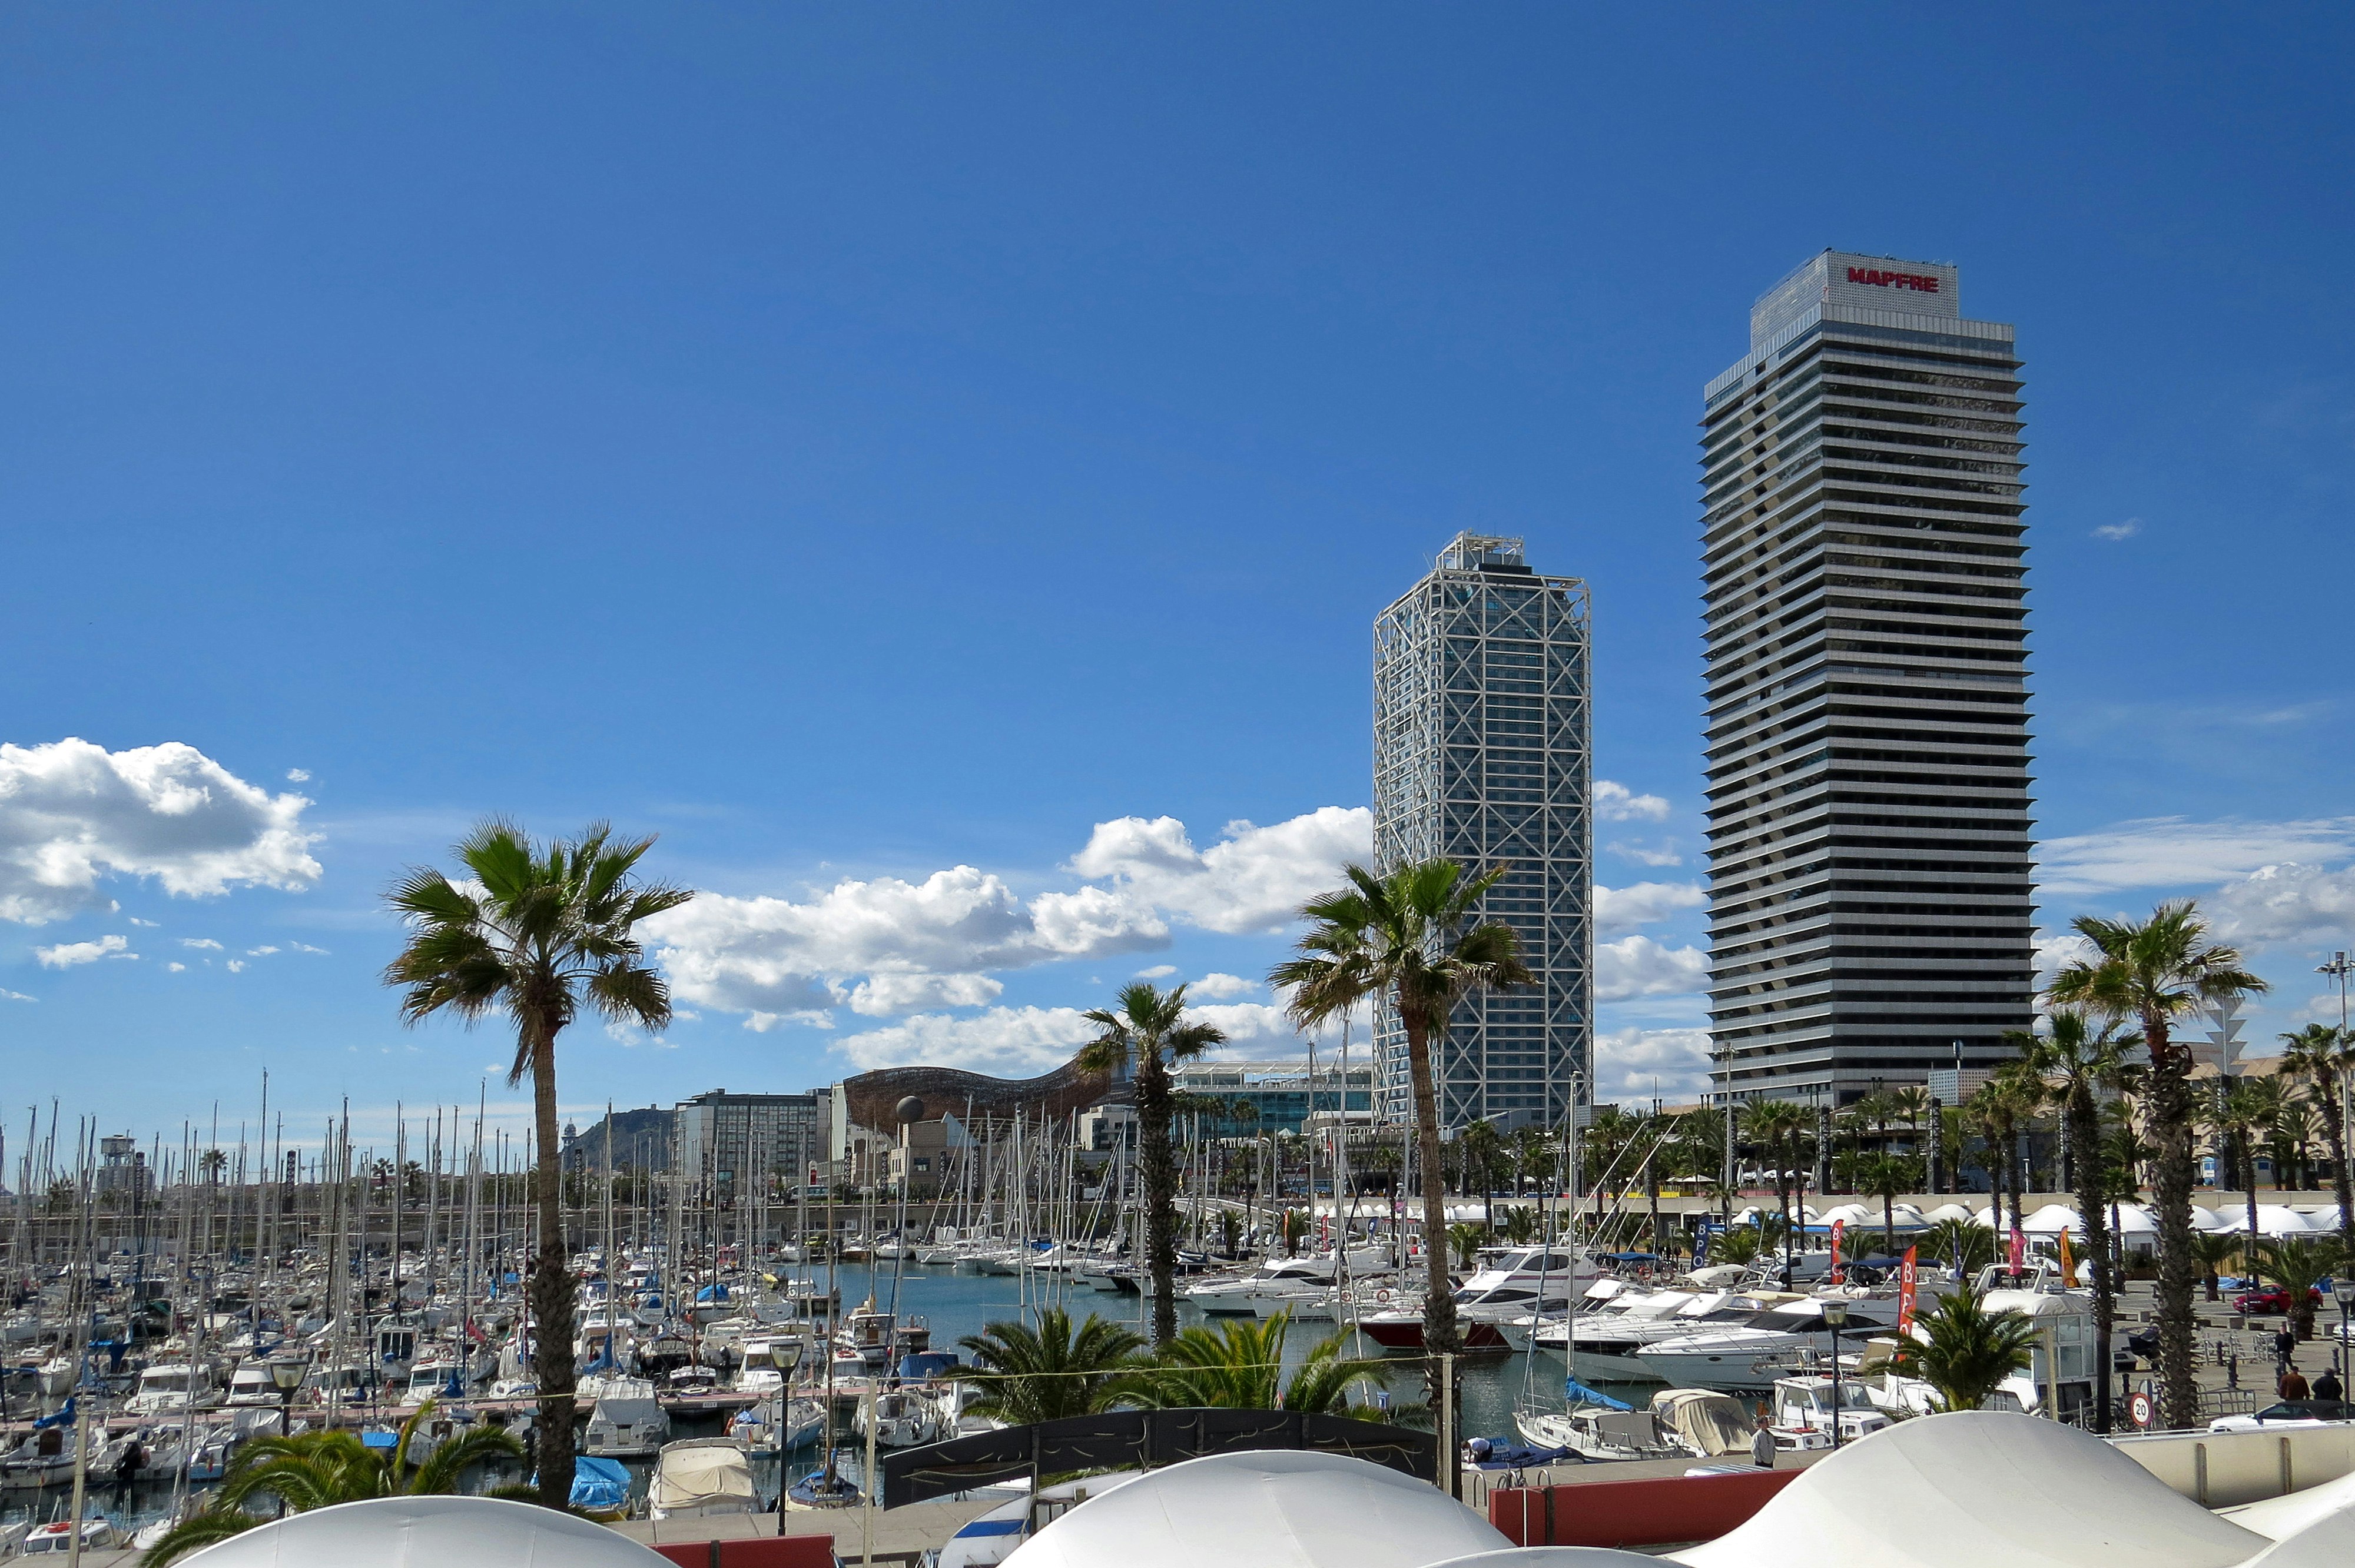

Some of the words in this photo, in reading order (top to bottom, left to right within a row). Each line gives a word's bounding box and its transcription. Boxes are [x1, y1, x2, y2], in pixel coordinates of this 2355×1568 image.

[1847, 267, 1940, 293] MAPFRE
[1693, 1224, 1706, 1267] BPO
[1832, 1227, 1842, 1276] BO
[2136, 1403, 2147, 1416] 20
